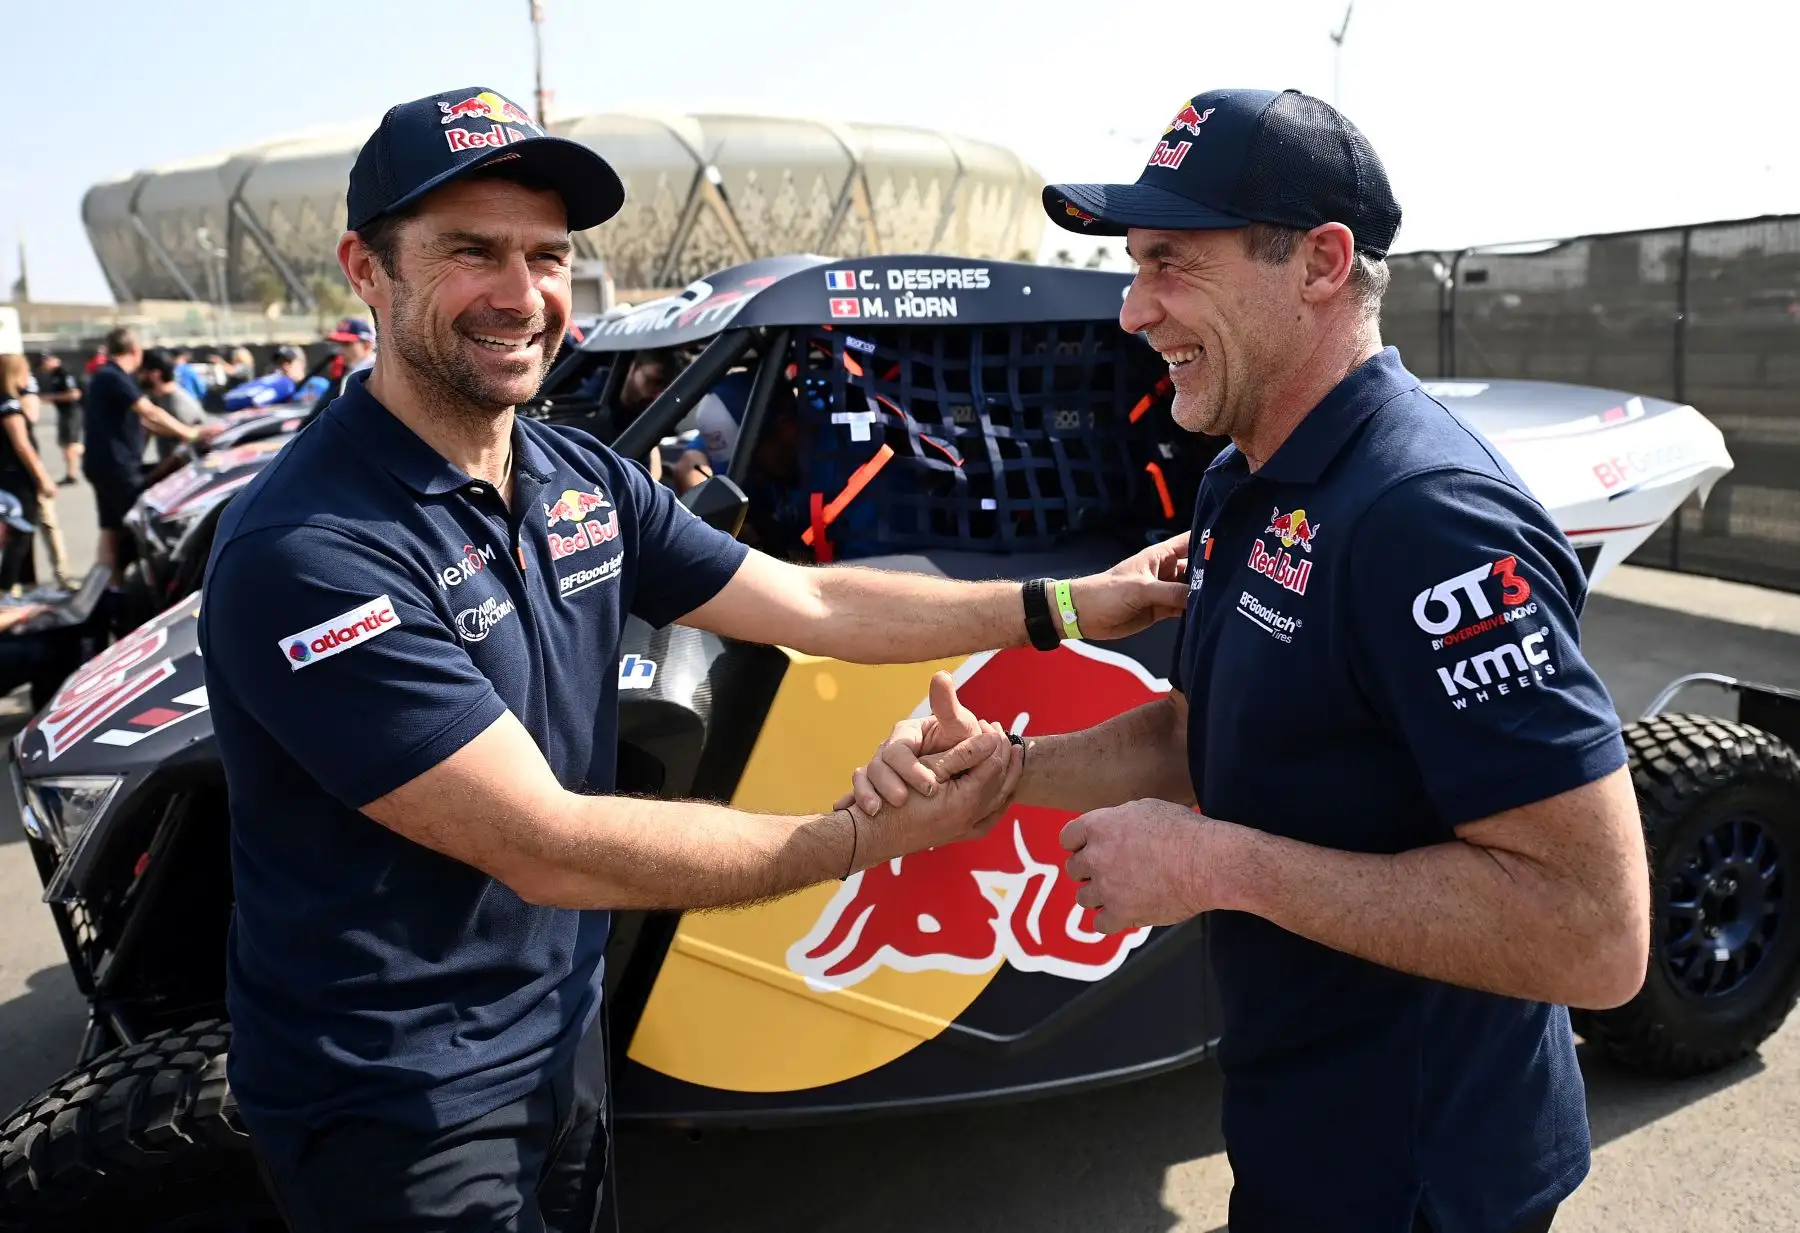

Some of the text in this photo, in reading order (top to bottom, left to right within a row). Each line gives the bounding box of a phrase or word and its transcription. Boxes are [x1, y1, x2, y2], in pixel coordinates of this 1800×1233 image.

[445, 124, 508, 152] Red
[1148, 140, 1193, 169] Bull
[859, 268, 991, 290] C. DESPRES
[862, 296, 958, 318] M. HORN
[547, 510, 620, 560] Red Bull
[1247, 538, 1283, 580] Red
[1273, 552, 1313, 596] Bull
[478, 596, 497, 618] AUTO
[310, 608, 395, 653] atlantic
[1271, 627, 1292, 644] Tires
[1452, 664, 1556, 710] WHEELS
